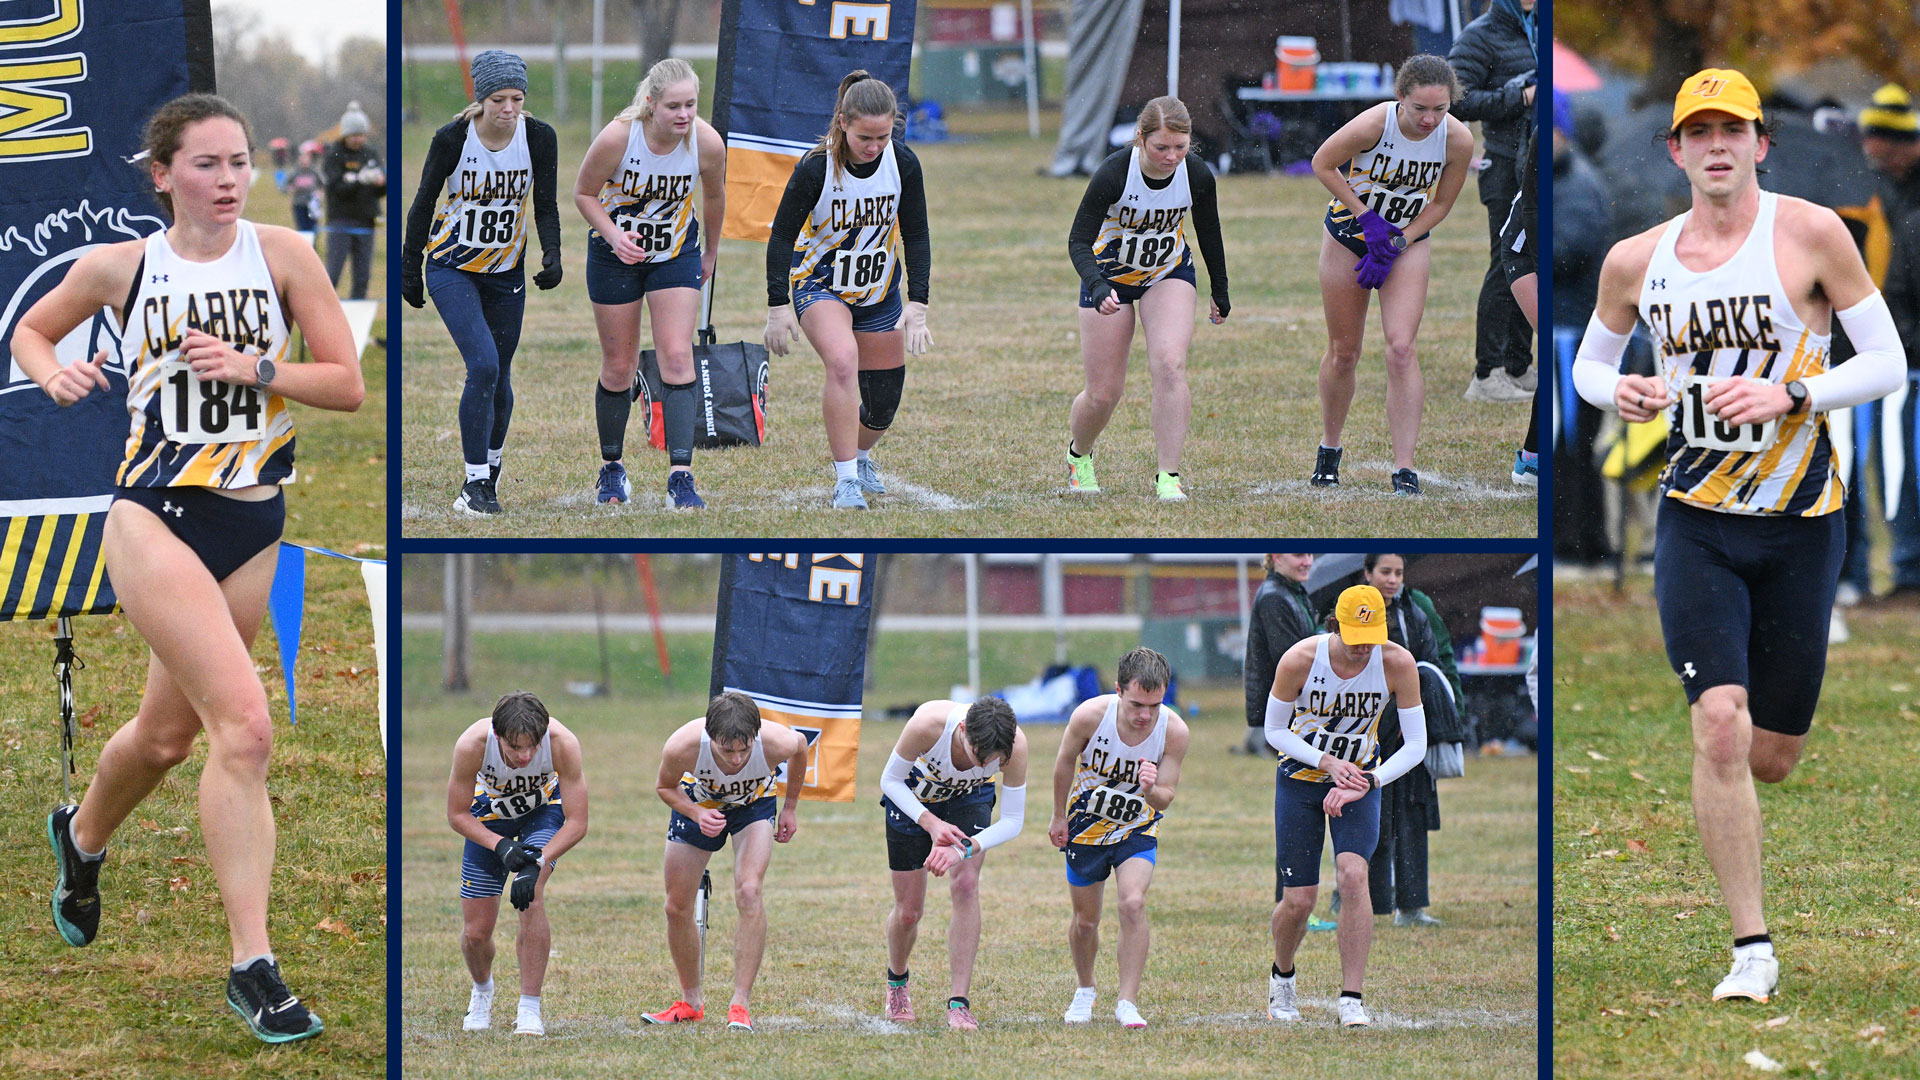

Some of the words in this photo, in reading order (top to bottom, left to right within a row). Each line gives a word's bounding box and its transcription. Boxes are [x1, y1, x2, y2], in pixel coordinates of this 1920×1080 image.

[1691, 75, 1730, 98] CU
[461, 169, 528, 201] CLARKE
[621, 169, 692, 201] CLARKE
[1369, 153, 1442, 188] CLARKE
[831, 195, 896, 232] CLARKE
[1119, 206, 1188, 232] CLARKE
[1374, 191, 1424, 224] 184
[464, 208, 515, 244] 183
[1126, 236, 1176, 268] 182
[839, 251, 887, 288] 186
[143, 289, 270, 359] CLARKE
[1649, 294, 1782, 357] CLARKE
[700, 359, 713, 398] JOHN'S
[168, 369, 261, 434] 184
[704, 399, 717, 437] JIMMY
[1355, 604, 1376, 624] CU
[1310, 690, 1382, 718] CLARKE
[1318, 733, 1363, 763] 191
[1092, 748, 1157, 785] CLAR
[494, 788, 543, 818] 187
[1093, 790, 1143, 823] 188
